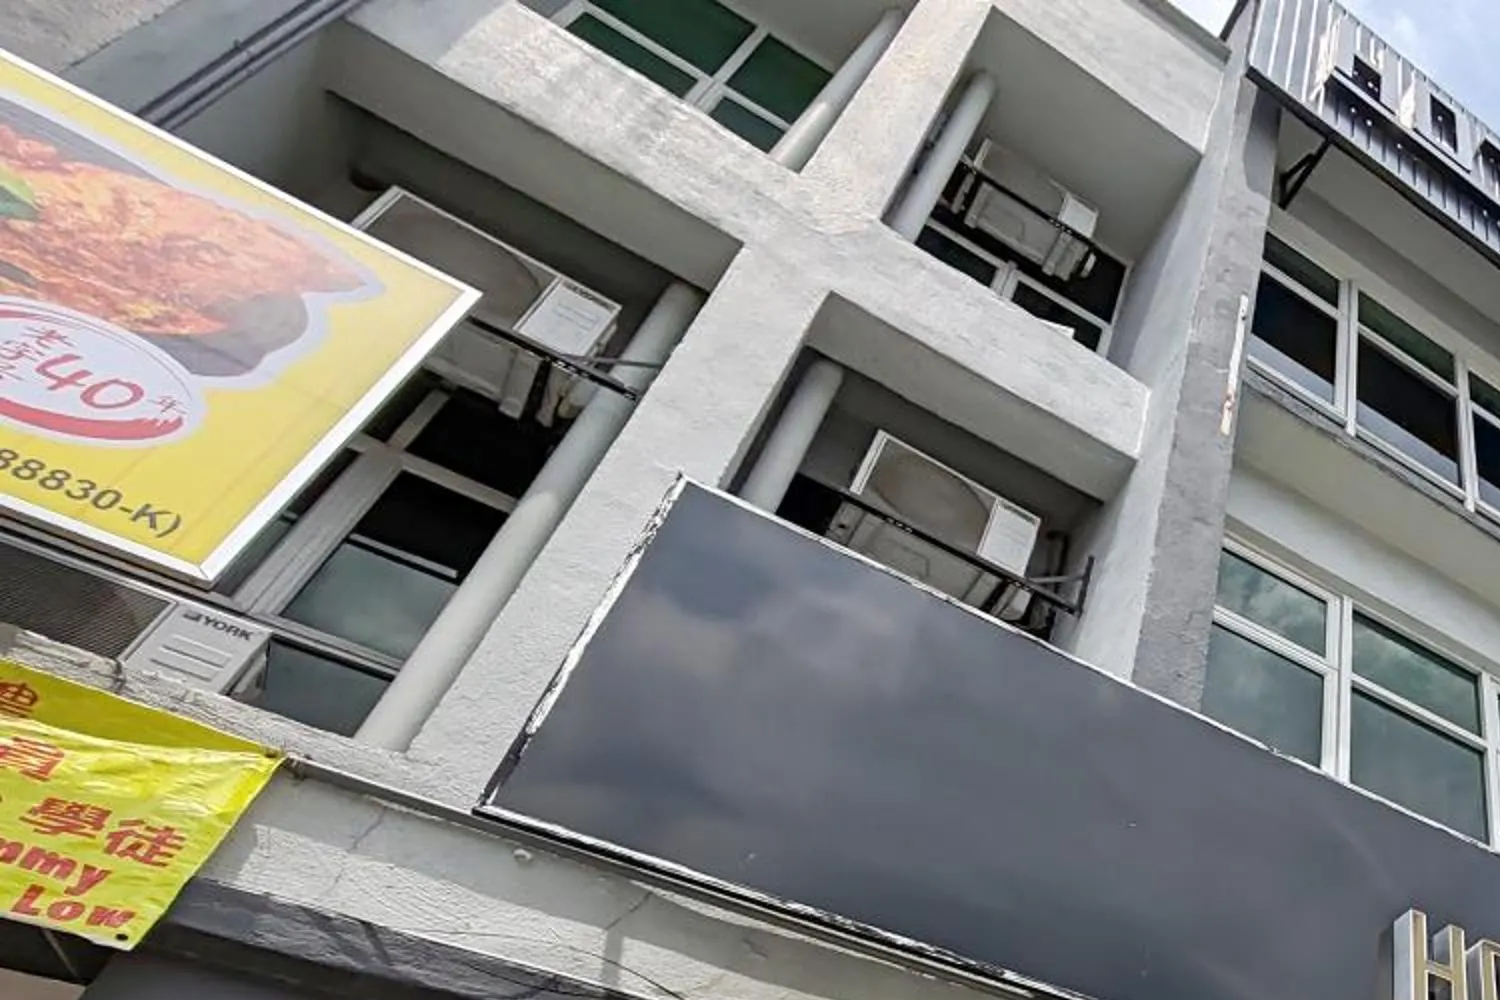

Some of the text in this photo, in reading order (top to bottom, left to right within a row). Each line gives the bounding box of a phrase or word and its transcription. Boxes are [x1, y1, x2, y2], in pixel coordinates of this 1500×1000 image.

[35, 353, 145, 410] 40
[200, 615, 255, 641] YORK
[19, 797, 186, 867] 學徒
[11, 884, 136, 928] Low
